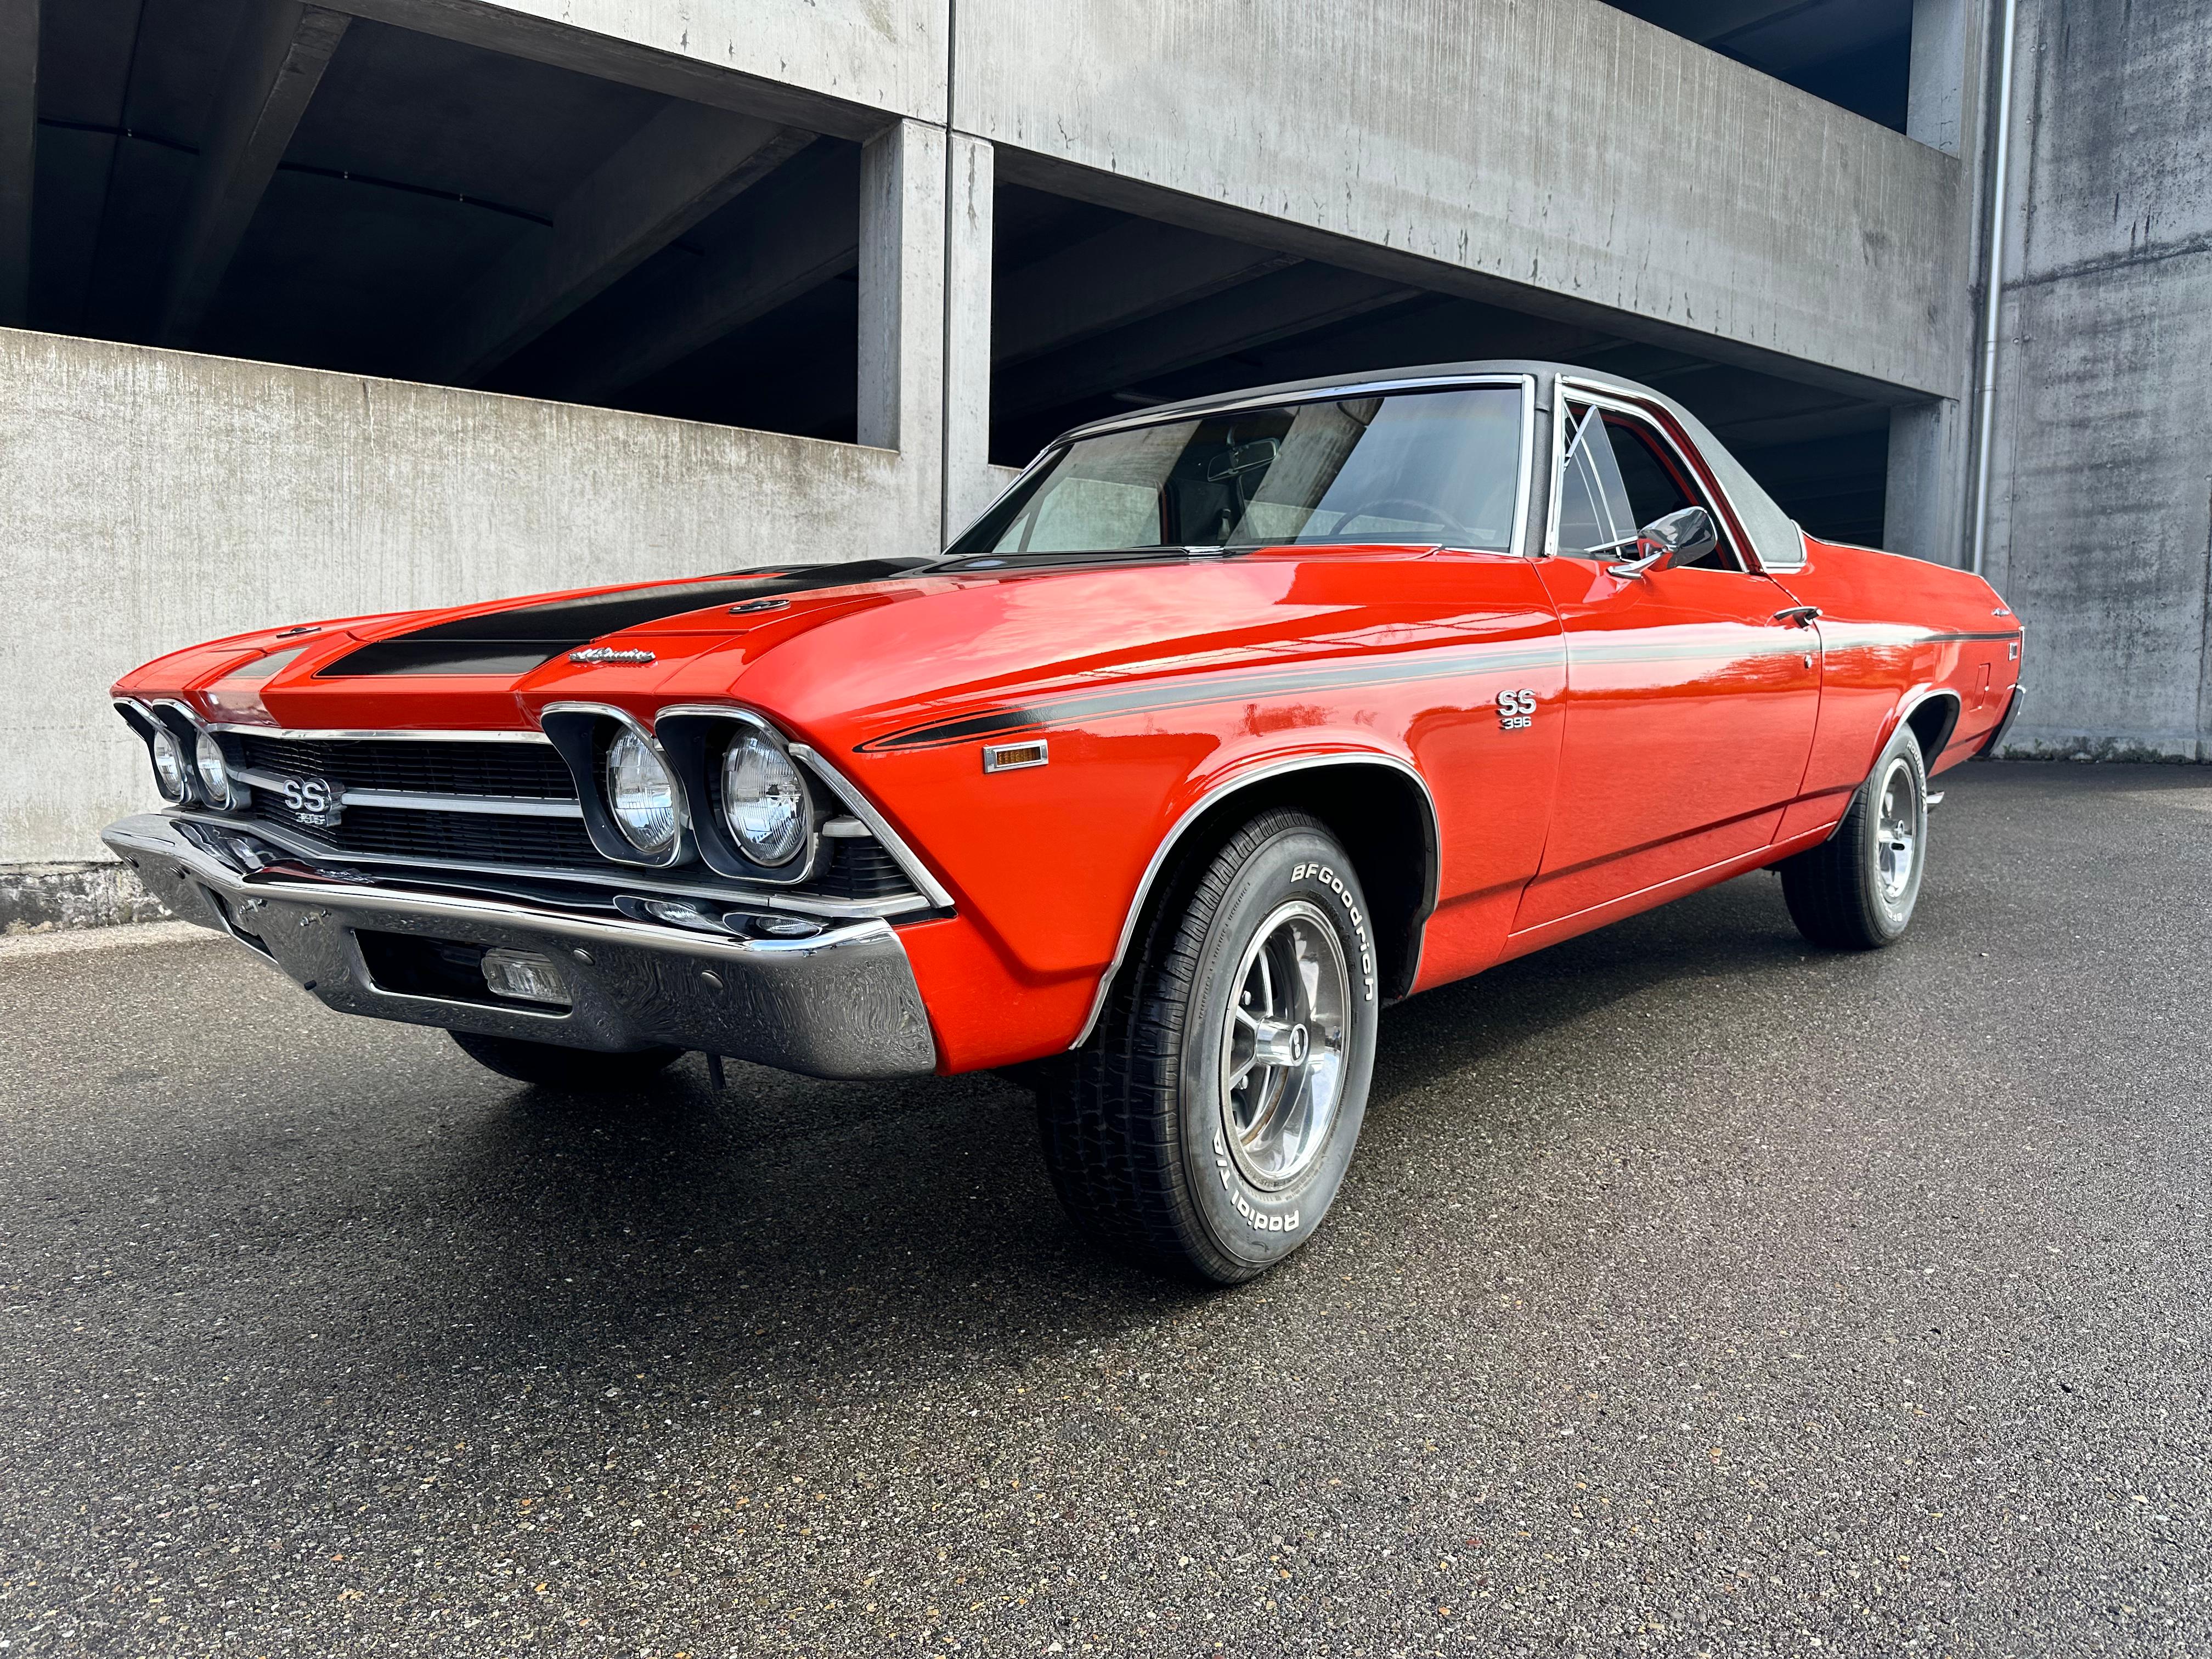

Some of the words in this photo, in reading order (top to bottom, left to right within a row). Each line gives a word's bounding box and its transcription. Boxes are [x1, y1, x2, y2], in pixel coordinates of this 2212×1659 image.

[1498, 689, 1537, 716] SS
[1502, 716, 1532, 730] 396
[1906, 740, 1925, 779] Radial
[283, 779, 325, 812] SS
[1290, 863, 1374, 1001] BFGoodrich
[1231, 1189, 1300, 1232] Radial
